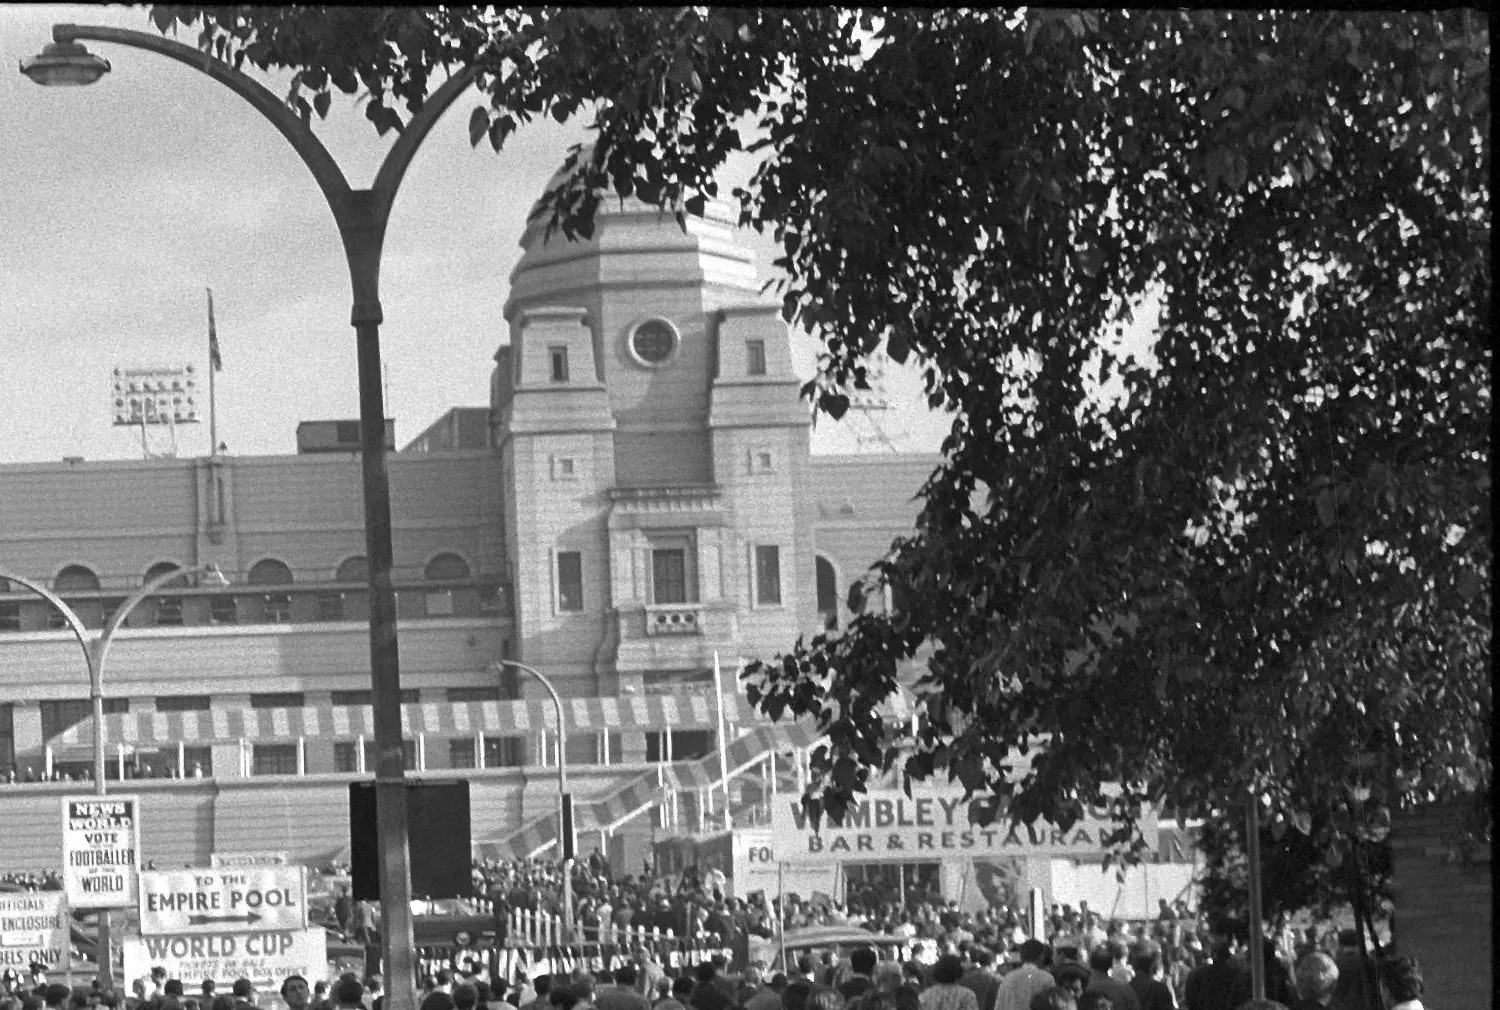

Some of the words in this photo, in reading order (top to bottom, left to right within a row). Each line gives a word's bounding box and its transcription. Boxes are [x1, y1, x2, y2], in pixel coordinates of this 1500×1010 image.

[76, 803, 126, 816] NEWS
[790, 799, 961, 830] WMBLEY
[69, 817, 131, 830] WORLD
[85, 832, 118, 844] VOTE
[808, 834, 874, 852] BAR
[886, 833, 904, 849] &
[918, 829, 1140, 851] RESTAURAN
[70, 848, 135, 866] FOOTBALLER
[749, 847, 774, 862] FO
[82, 875, 124, 892] WORLD
[196, 875, 214, 886] TO
[220, 874, 247, 886] THE
[148, 891, 220, 912] EMPIRE
[231, 889, 296, 909] POOL
[2, 915, 61, 931] ENCLOSURE
[145, 934, 237, 960] WORLD
[245, 931, 294, 957] CUP
[28, 948, 61, 964] ONLY
[669, 948, 733, 969] EVENS
